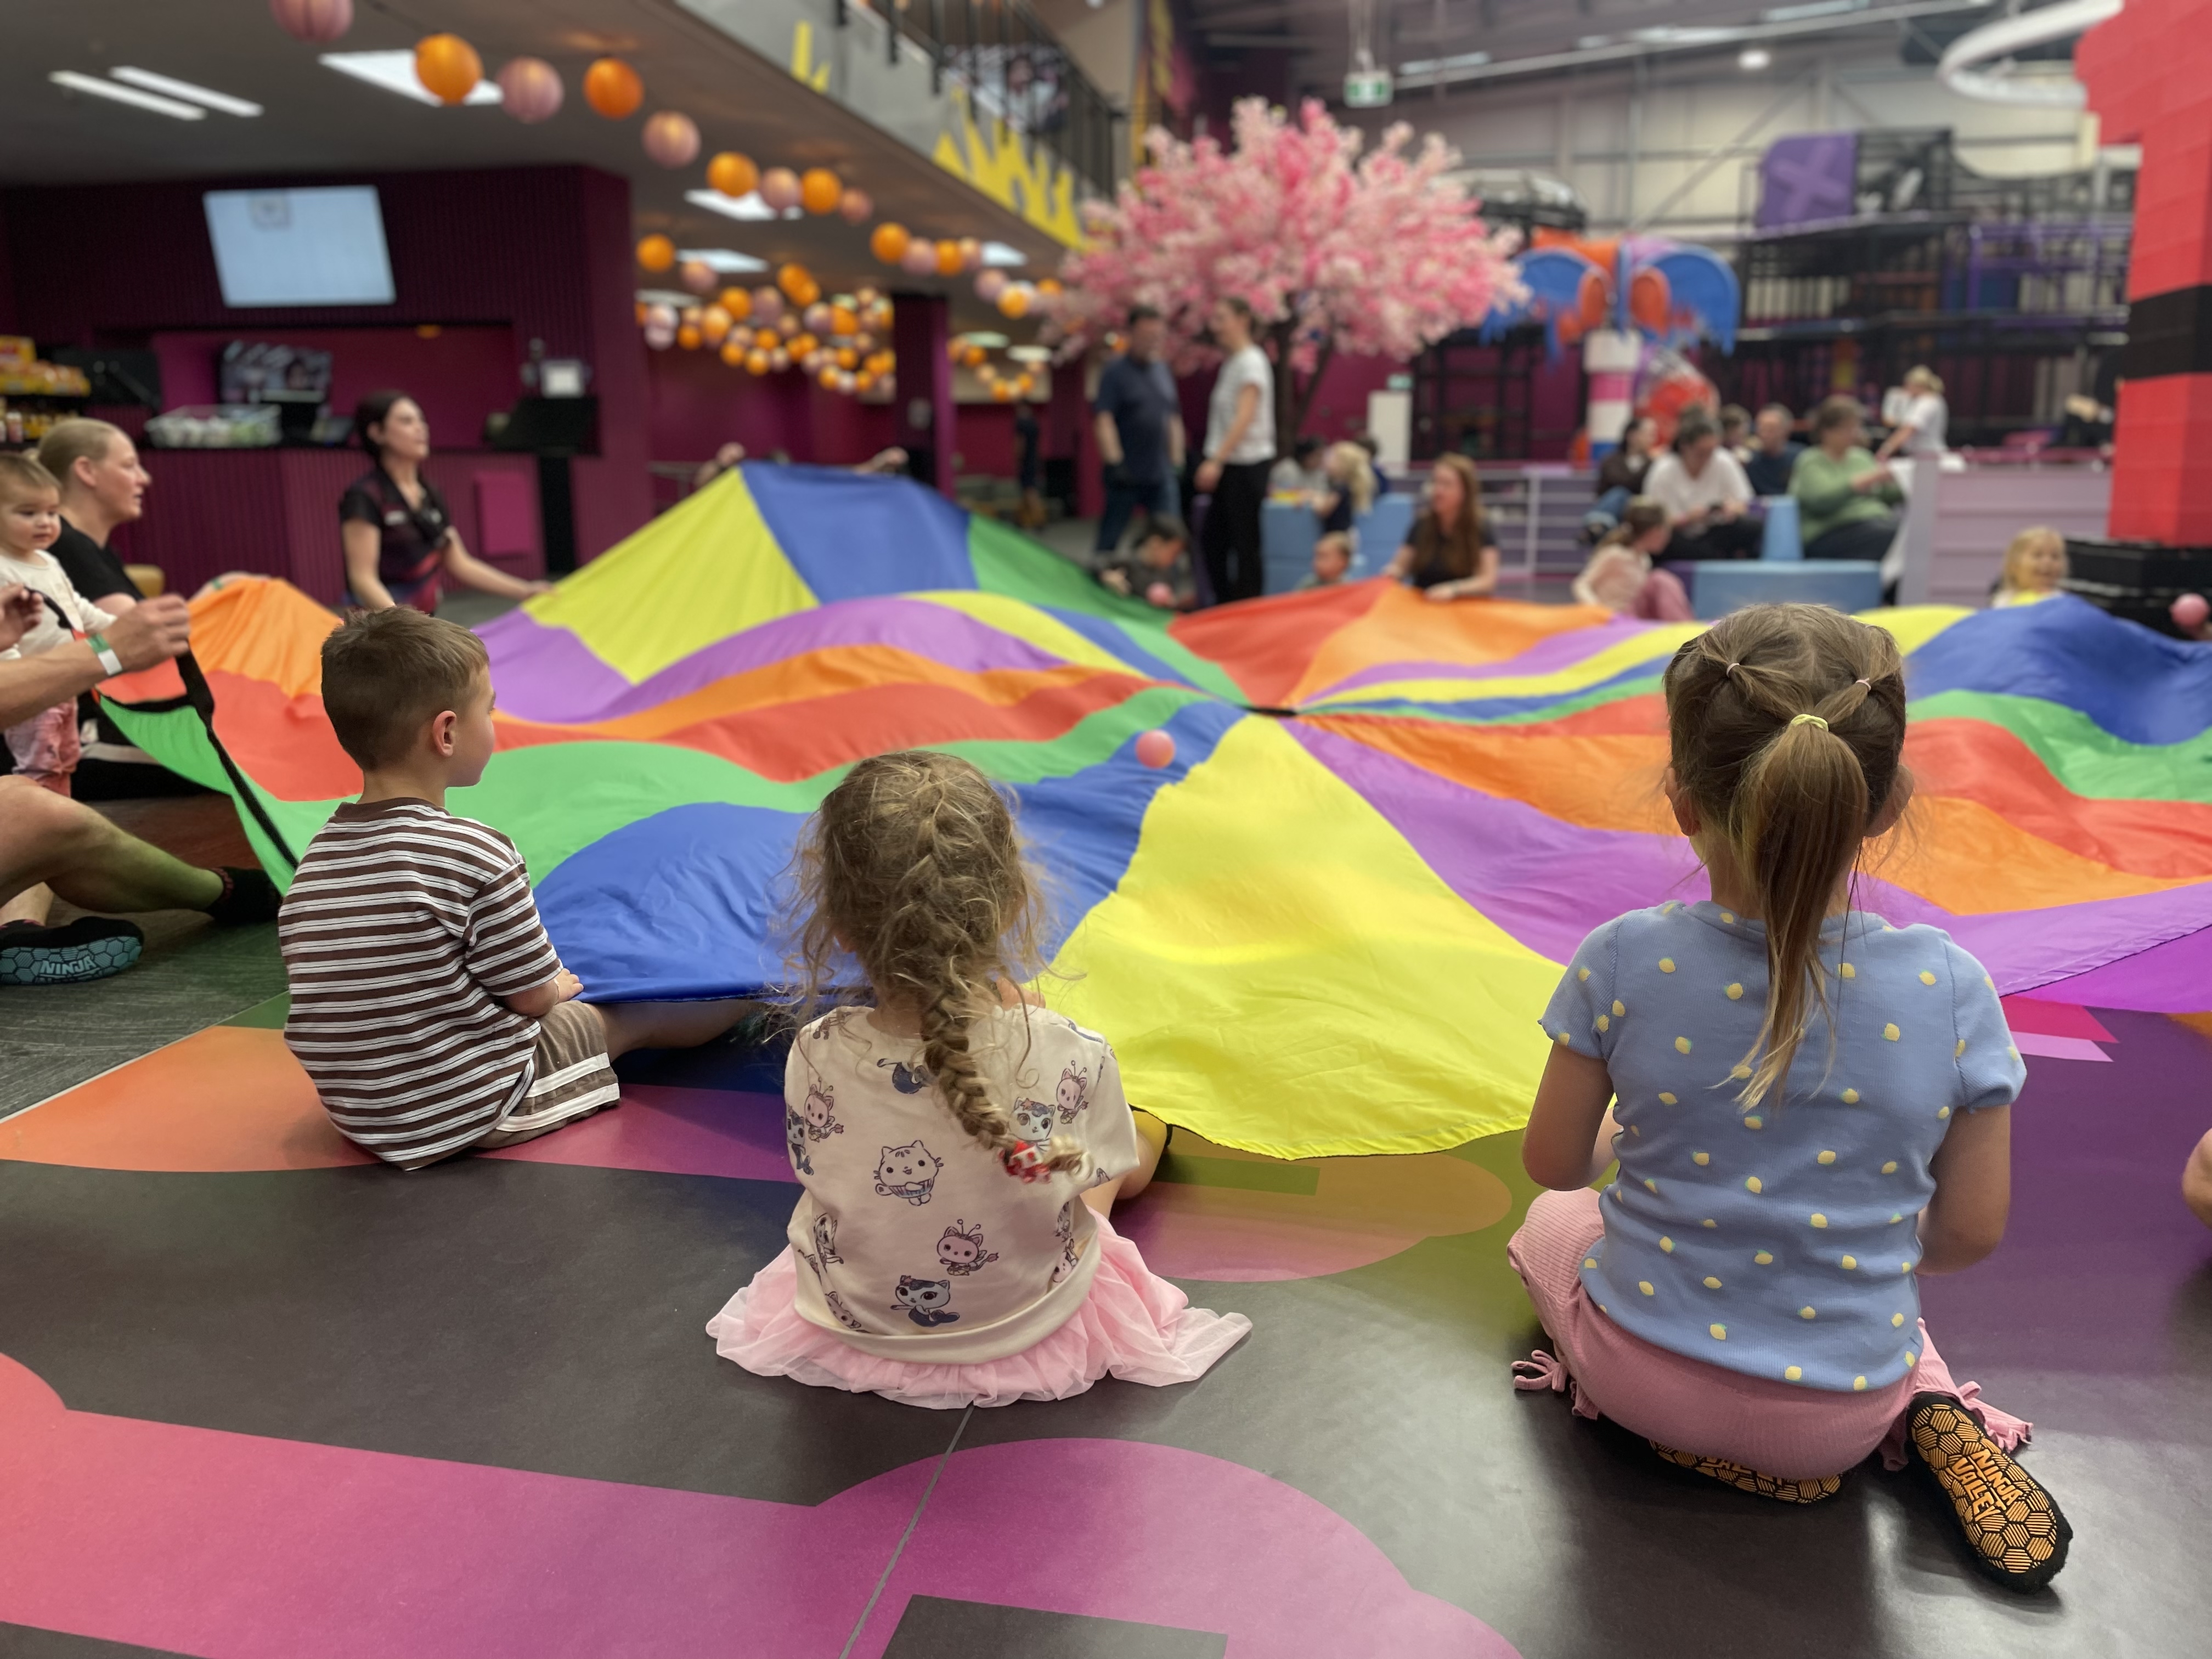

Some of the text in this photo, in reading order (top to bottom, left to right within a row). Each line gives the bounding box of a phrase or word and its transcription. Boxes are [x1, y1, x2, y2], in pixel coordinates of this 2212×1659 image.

[40, 956, 97, 975] NINJA
[1946, 1457, 2001, 1521] VALLEY
[1971, 1448, 2023, 1505] NINJA
